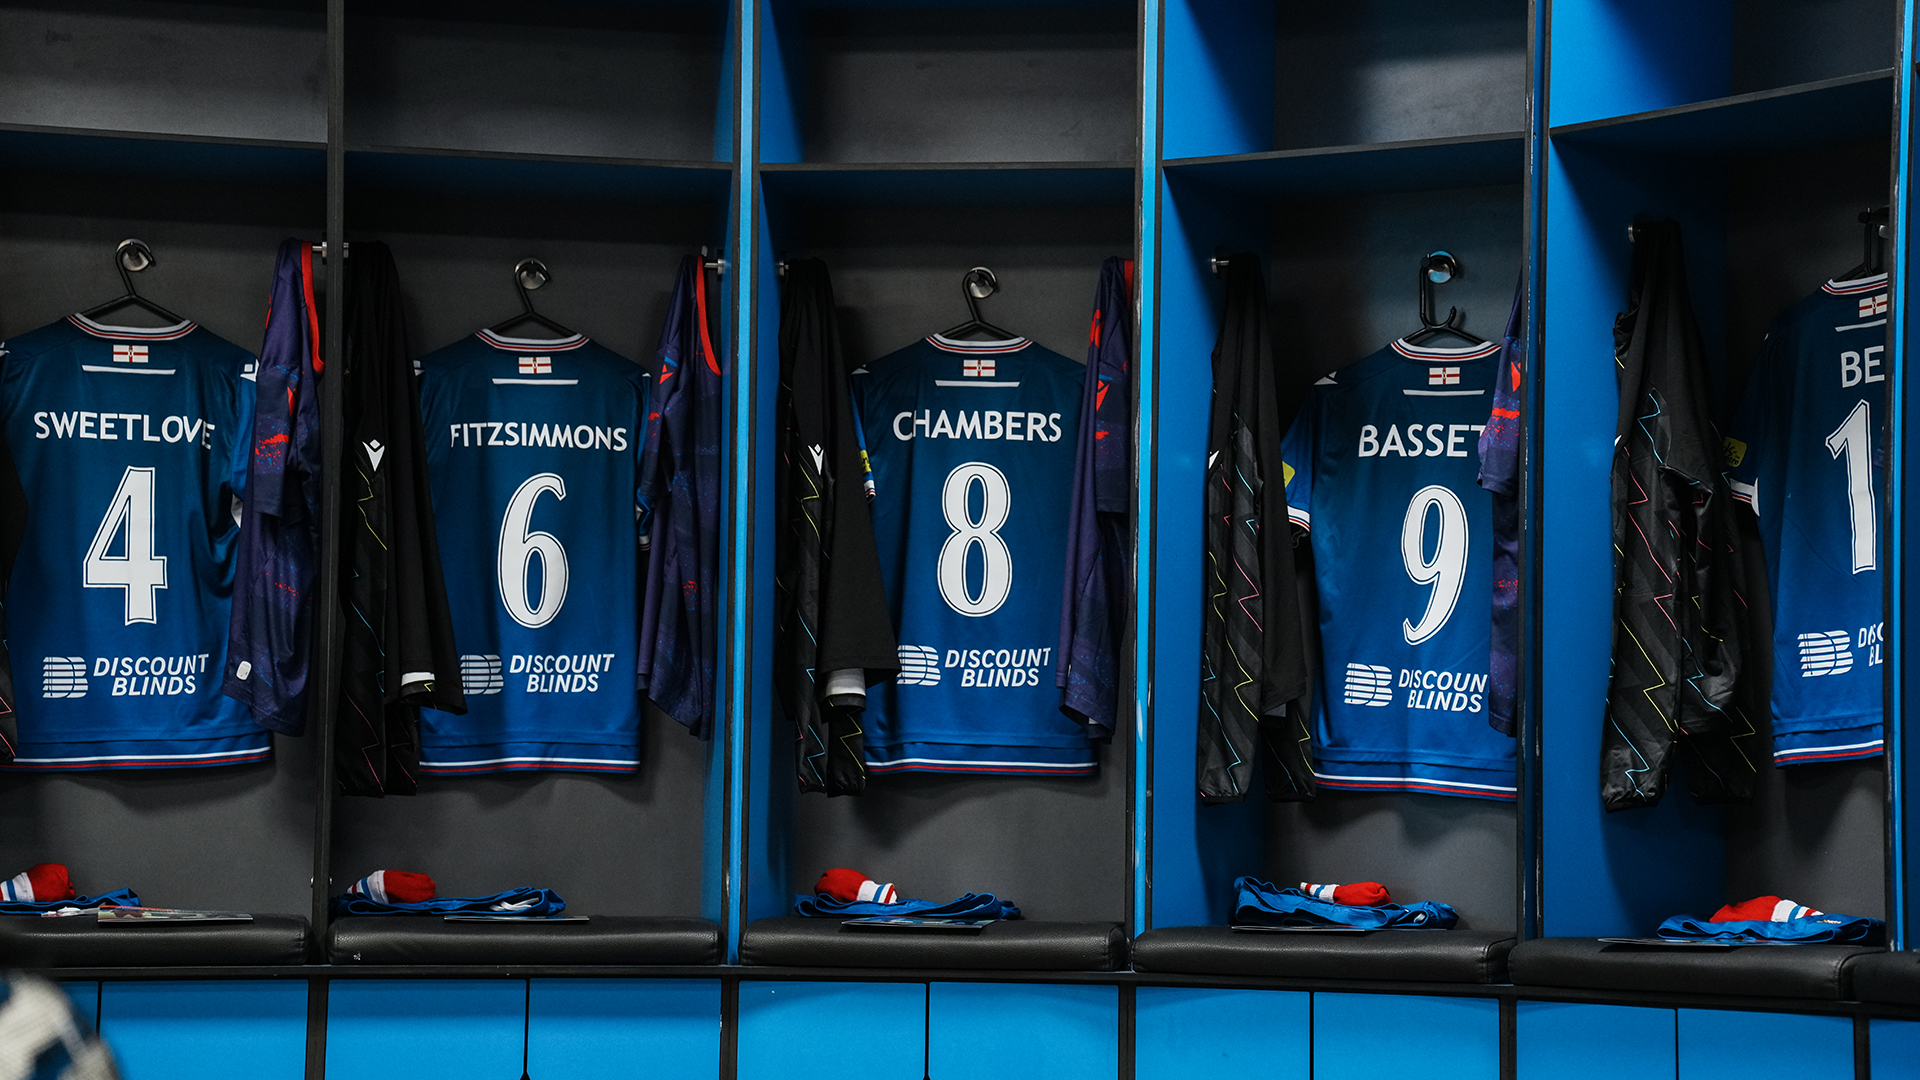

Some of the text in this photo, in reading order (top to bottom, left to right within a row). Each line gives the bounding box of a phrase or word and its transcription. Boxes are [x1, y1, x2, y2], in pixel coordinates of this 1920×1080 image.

[1841, 346, 1884, 388] BE
[34, 411, 215, 450] SWEETLOVE
[450, 421, 628, 452] FITZSIMMONS
[893, 409, 1062, 443] CHAMBERS
[1825, 399, 1876, 574] 1
[83, 466, 168, 626] 4
[498, 473, 569, 628] 6
[937, 462, 1012, 617] 8
[1401, 485, 1468, 645] 9
[93, 653, 210, 677] DISCOUNT
[509, 653, 615, 674] DISCOUNT
[945, 647, 1051, 669] DISCOUNT
[111, 674, 196, 696] BLINDS
[526, 673, 599, 693] BLINDS
[961, 667, 1039, 687] BLINDS
[1407, 689, 1483, 713] BLINDS
